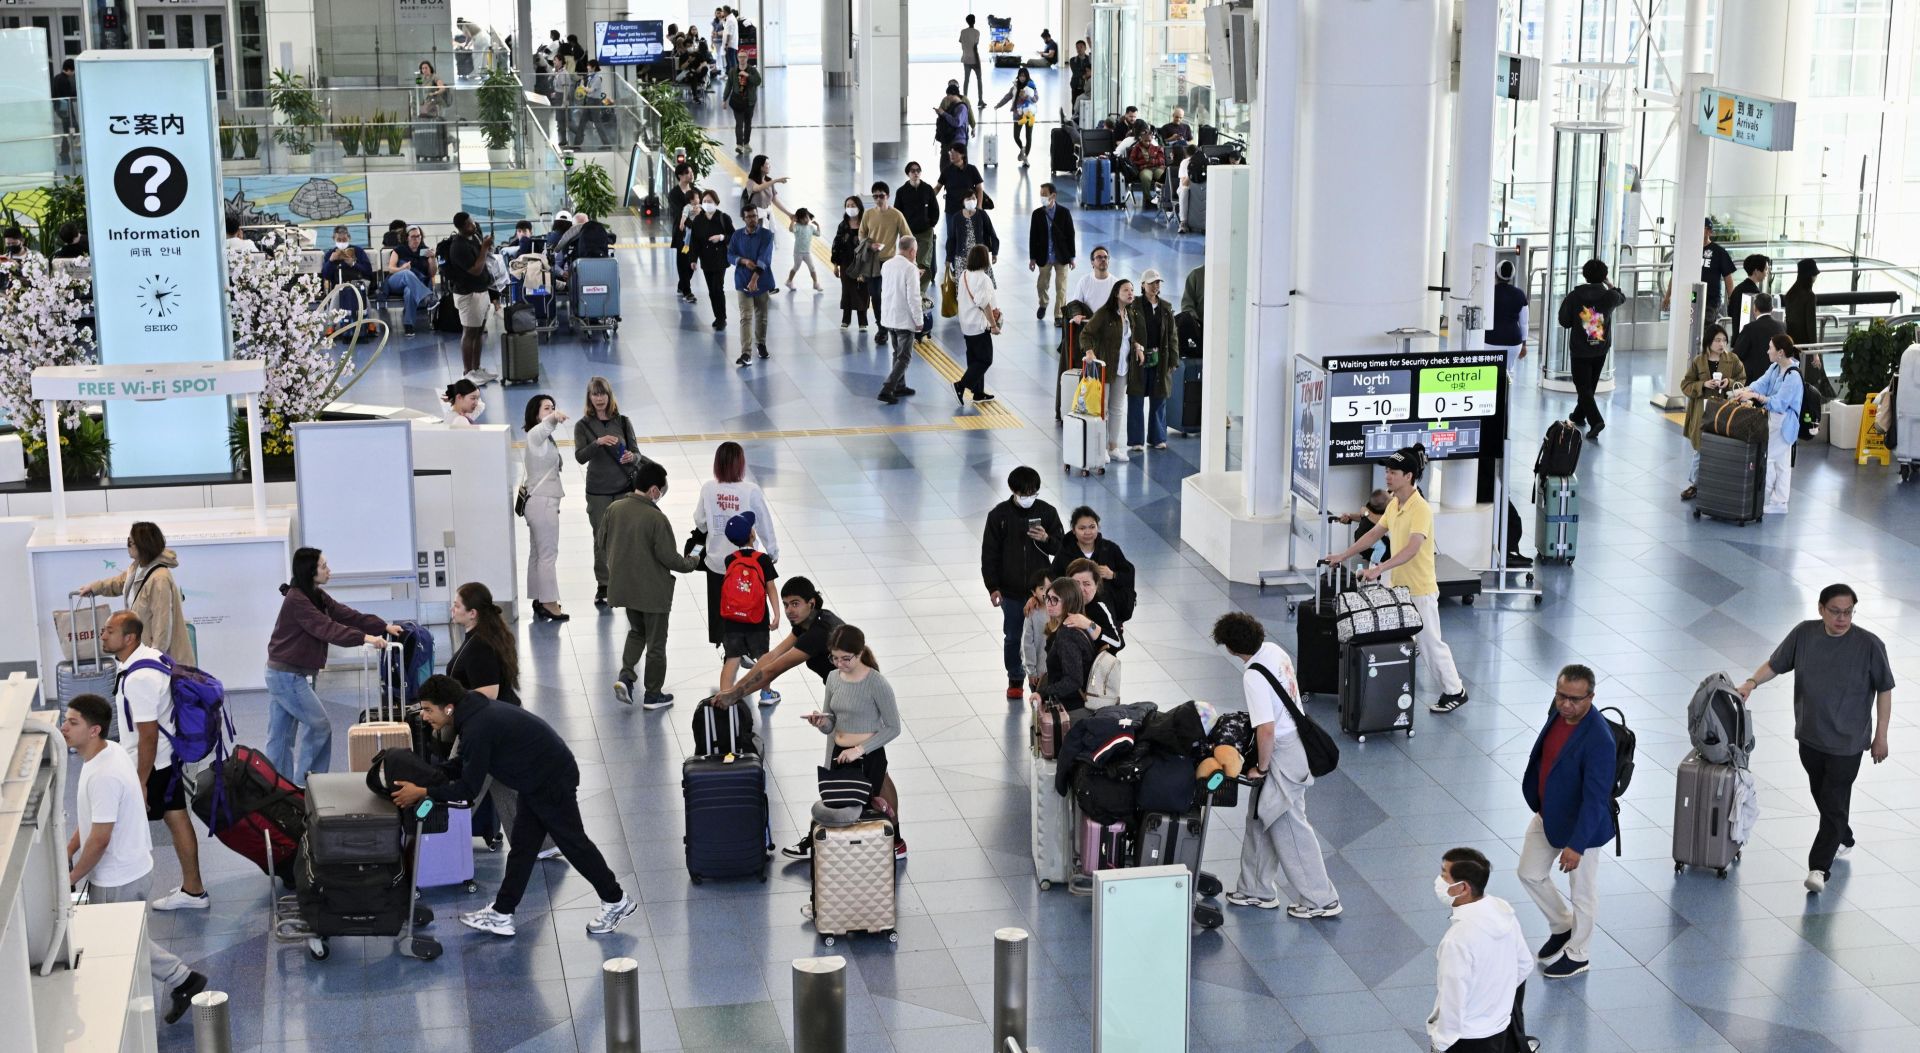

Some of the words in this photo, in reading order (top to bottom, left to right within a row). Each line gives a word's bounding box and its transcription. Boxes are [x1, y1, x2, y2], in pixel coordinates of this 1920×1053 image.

[1510, 72, 1518, 86] 3F
[1756, 108, 1763, 119] 2F
[108, 113, 185, 136] ご案内
[1736, 117, 1759, 132] Arrivals
[108, 227, 200, 240] Information
[130, 247, 152, 257] 问讯
[160, 246, 181, 256] 안내
[144, 324, 178, 332] SEIKO
[1339, 361, 1368, 370] Waiting
[1401, 358, 1428, 367] Security
[1353, 373, 1390, 386] North
[1436, 369, 1481, 382] Central
[78, 382, 116, 395] FREE
[121, 380, 166, 395] Wi-Fi
[172, 378, 217, 393] SPOT
[1366, 386, 1376, 394] 北
[1450, 383, 1466, 391] 中央
[1348, 401, 1359, 417] 5
[1435, 397, 1446, 413] 0
[1463, 395, 1473, 412] 5
[717, 501, 740, 511] Kitty
